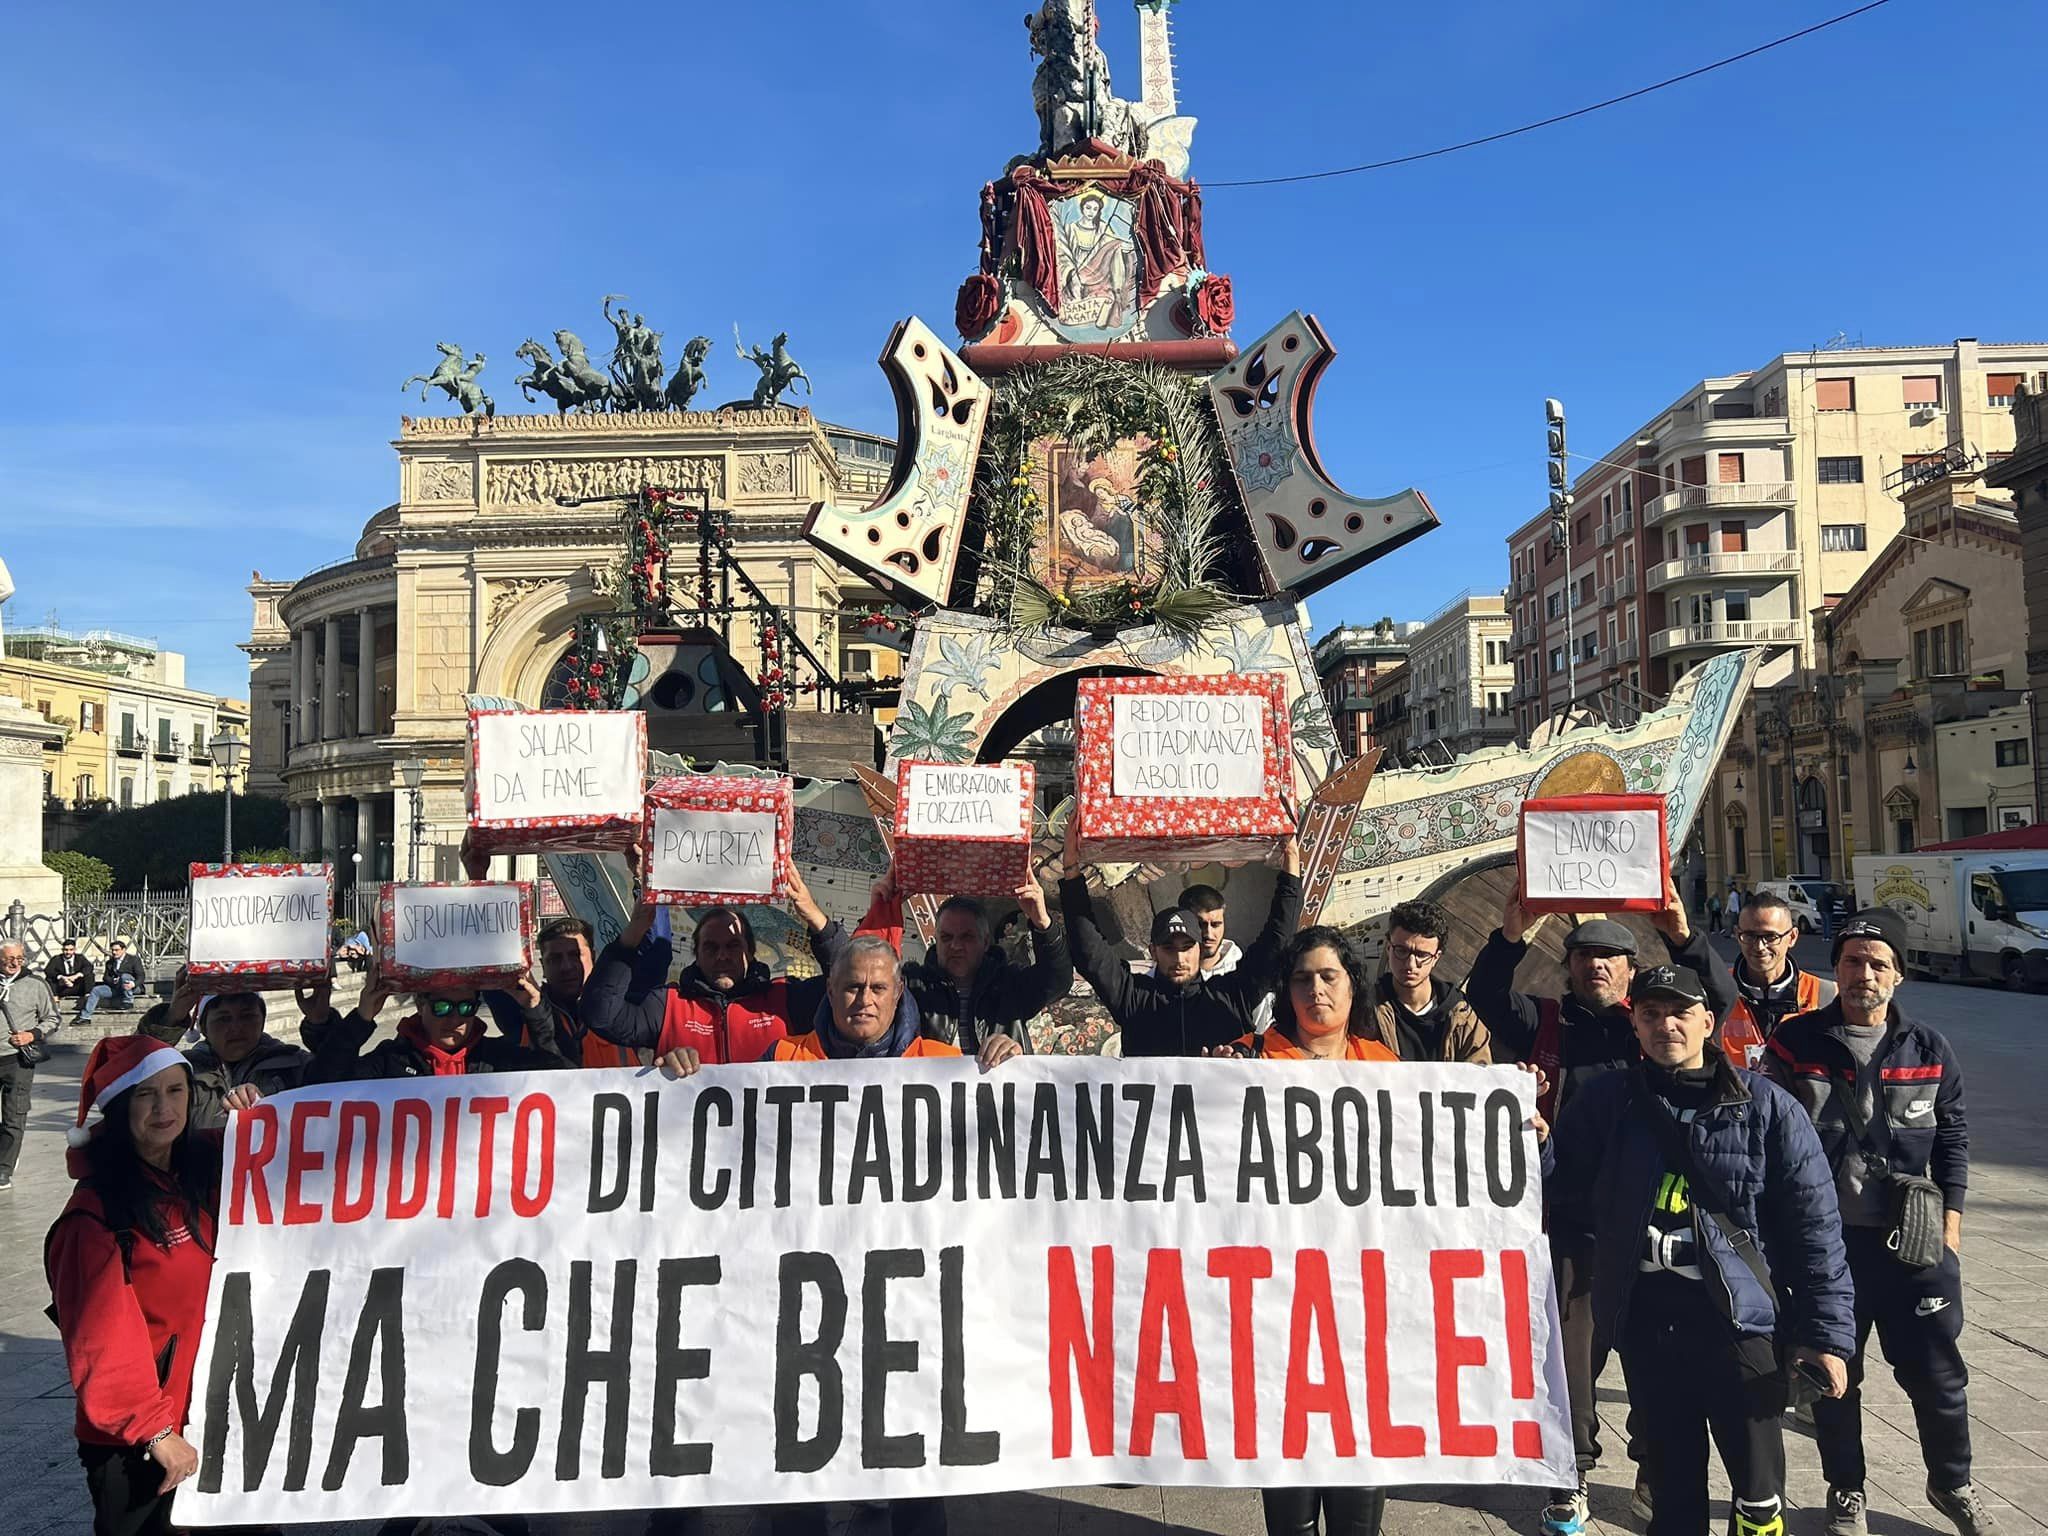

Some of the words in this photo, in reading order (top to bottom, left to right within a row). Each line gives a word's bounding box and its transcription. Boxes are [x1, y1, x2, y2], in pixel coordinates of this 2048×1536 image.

[1066, 300, 1100, 313] SANTA
[1067, 310, 1098, 321] AGATA
[1130, 699, 1211, 723] REDDITO
[1222, 700, 1246, 724] DI
[519, 722, 593, 759] SALARI
[1120, 728, 1259, 760] CITTADINANZA
[493, 772, 527, 804] DA
[542, 766, 602, 799] FAME
[925, 772, 1015, 797] EMIGRAZIONE
[1134, 762, 1220, 791] ABOLITO
[916, 799, 995, 825] FORZATA
[663, 828, 766, 867] POVERTÀ
[1554, 819, 1636, 856] LAVORO
[1548, 858, 1617, 892] NERO
[193, 893, 322, 931] DISOCCUPAZIONE
[402, 900, 520, 944] SFRUTTAMENTO
[228, 1092, 557, 1226] REDDITO
[587, 1090, 659, 1214] DI
[689, 1082, 1208, 1211] CITTADINANZA
[1236, 1086, 1526, 1209] ABOLITO
[196, 1266, 410, 1494] MA
[468, 1255, 722, 1487] CHE
[774, 1245, 1000, 1474] BEL
[1047, 1244, 1545, 1461] NATALE!
